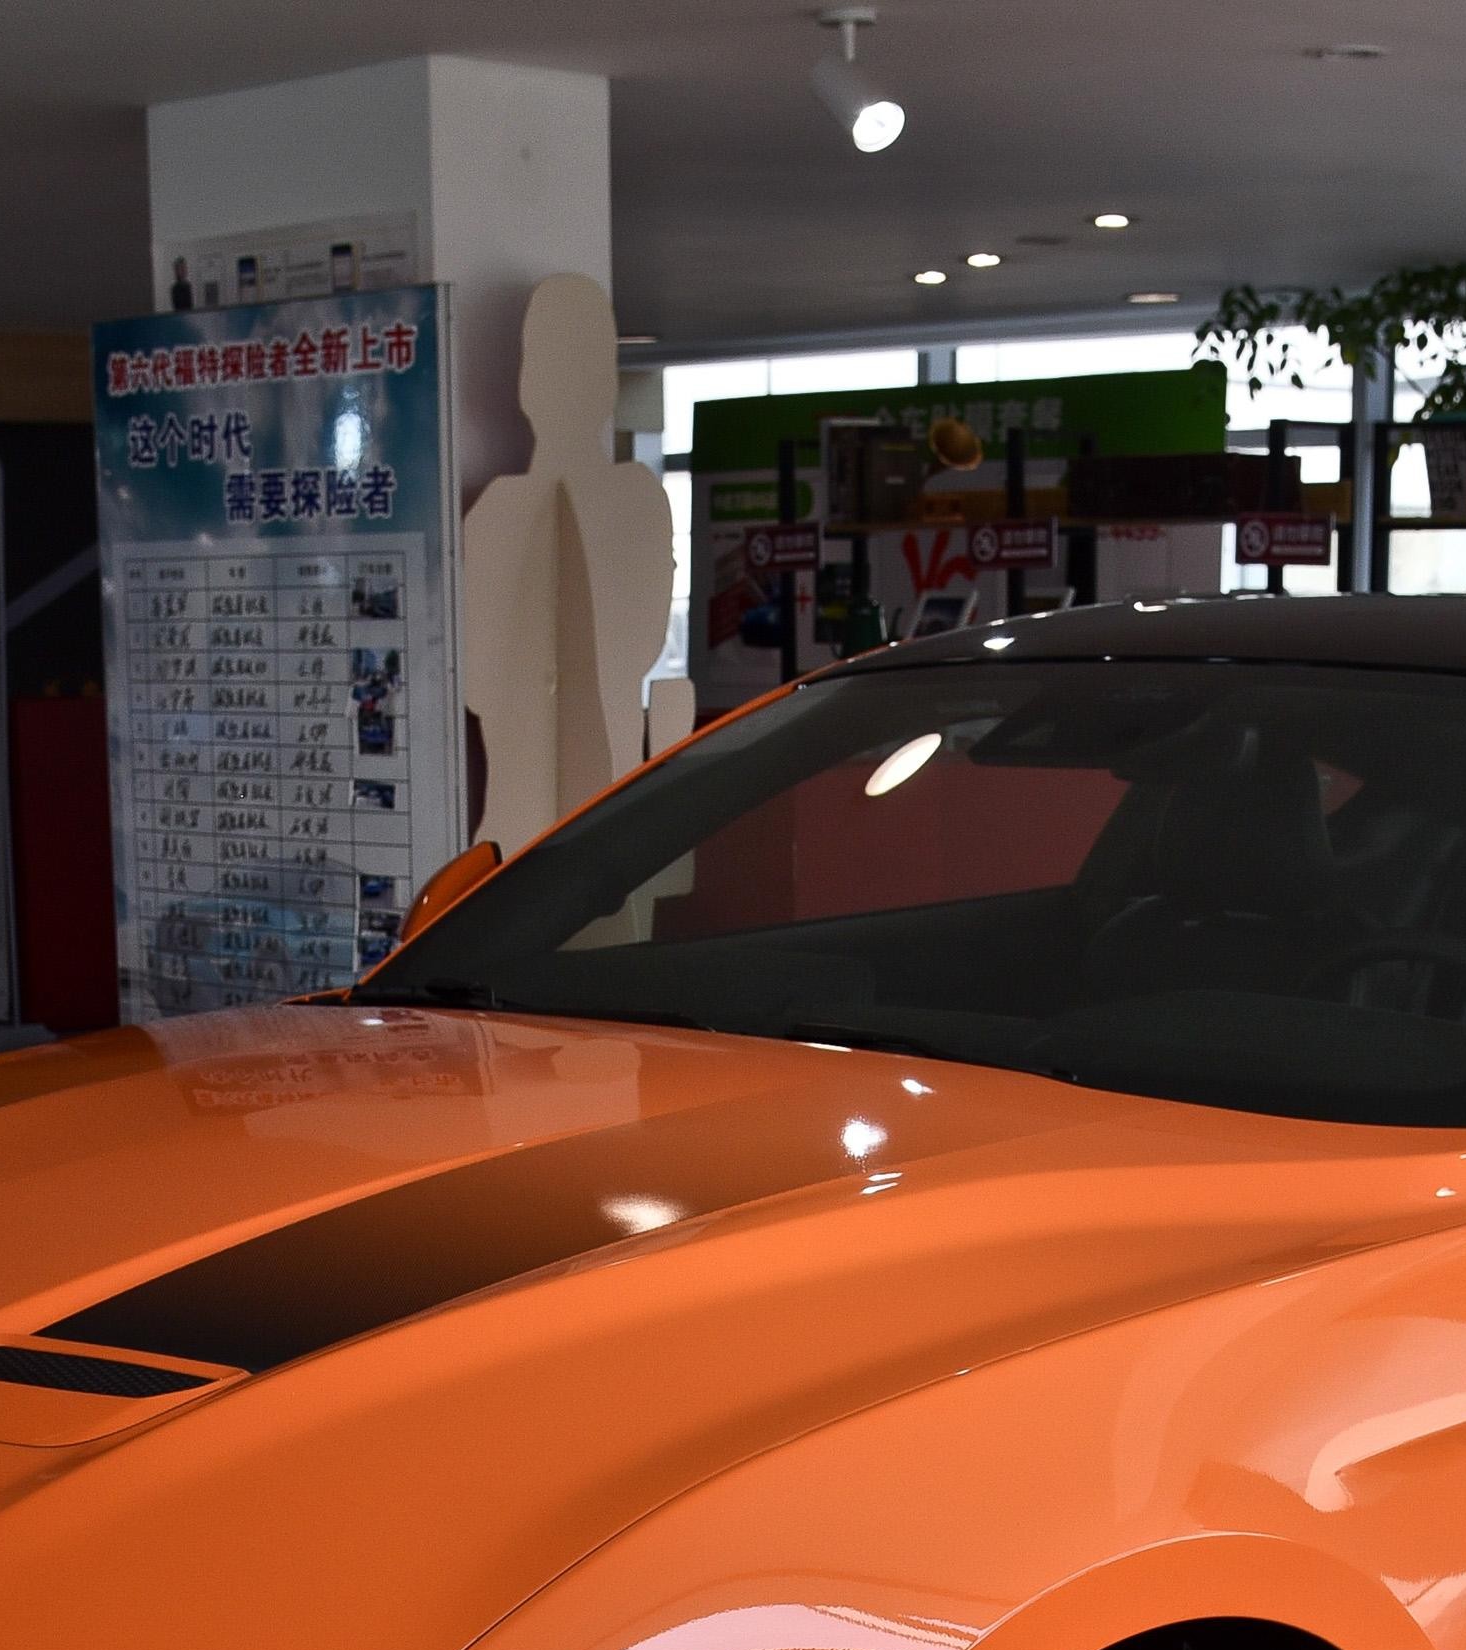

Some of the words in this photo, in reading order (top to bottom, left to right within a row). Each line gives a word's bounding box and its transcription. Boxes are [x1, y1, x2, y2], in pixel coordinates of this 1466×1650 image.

[108, 322, 418, 395] 第六代福特探险者全新上市
[128, 411, 253, 466] 这个时代
[224, 465, 396, 522] 需要探险者
